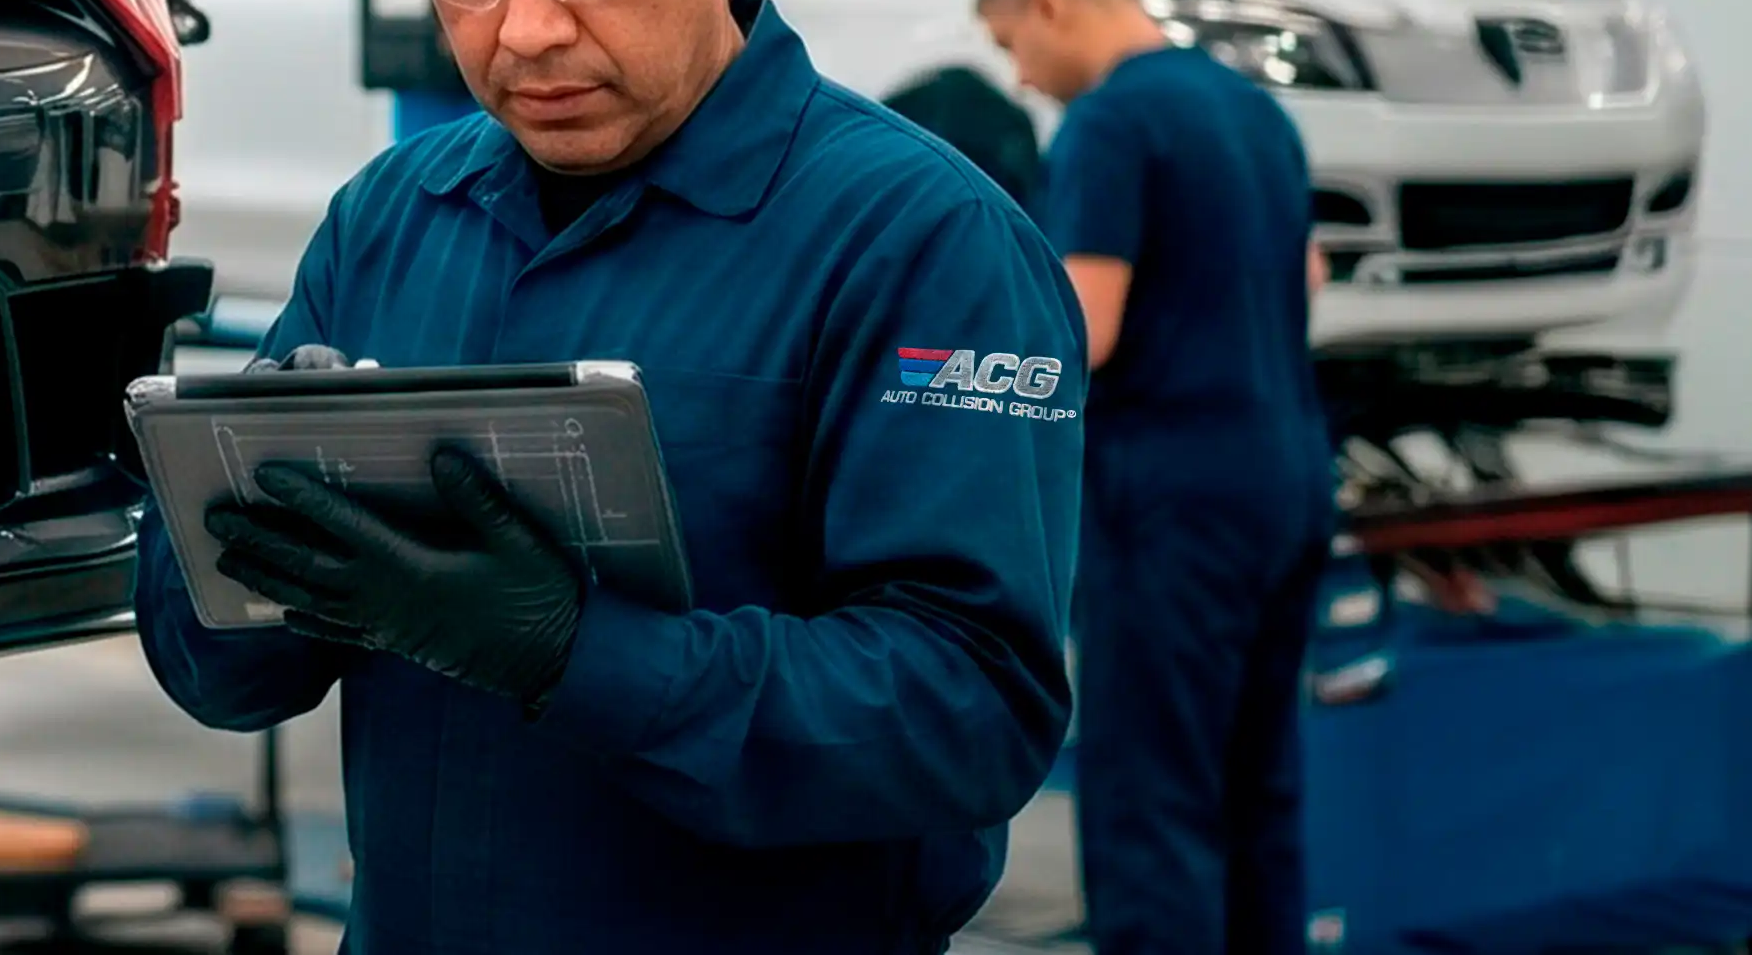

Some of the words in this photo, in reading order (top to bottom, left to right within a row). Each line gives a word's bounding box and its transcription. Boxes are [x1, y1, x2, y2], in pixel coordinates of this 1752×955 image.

[930, 350, 1061, 399] ACG
[882, 390, 917, 404] AUTO
[922, 393, 1004, 414] COLLISION
